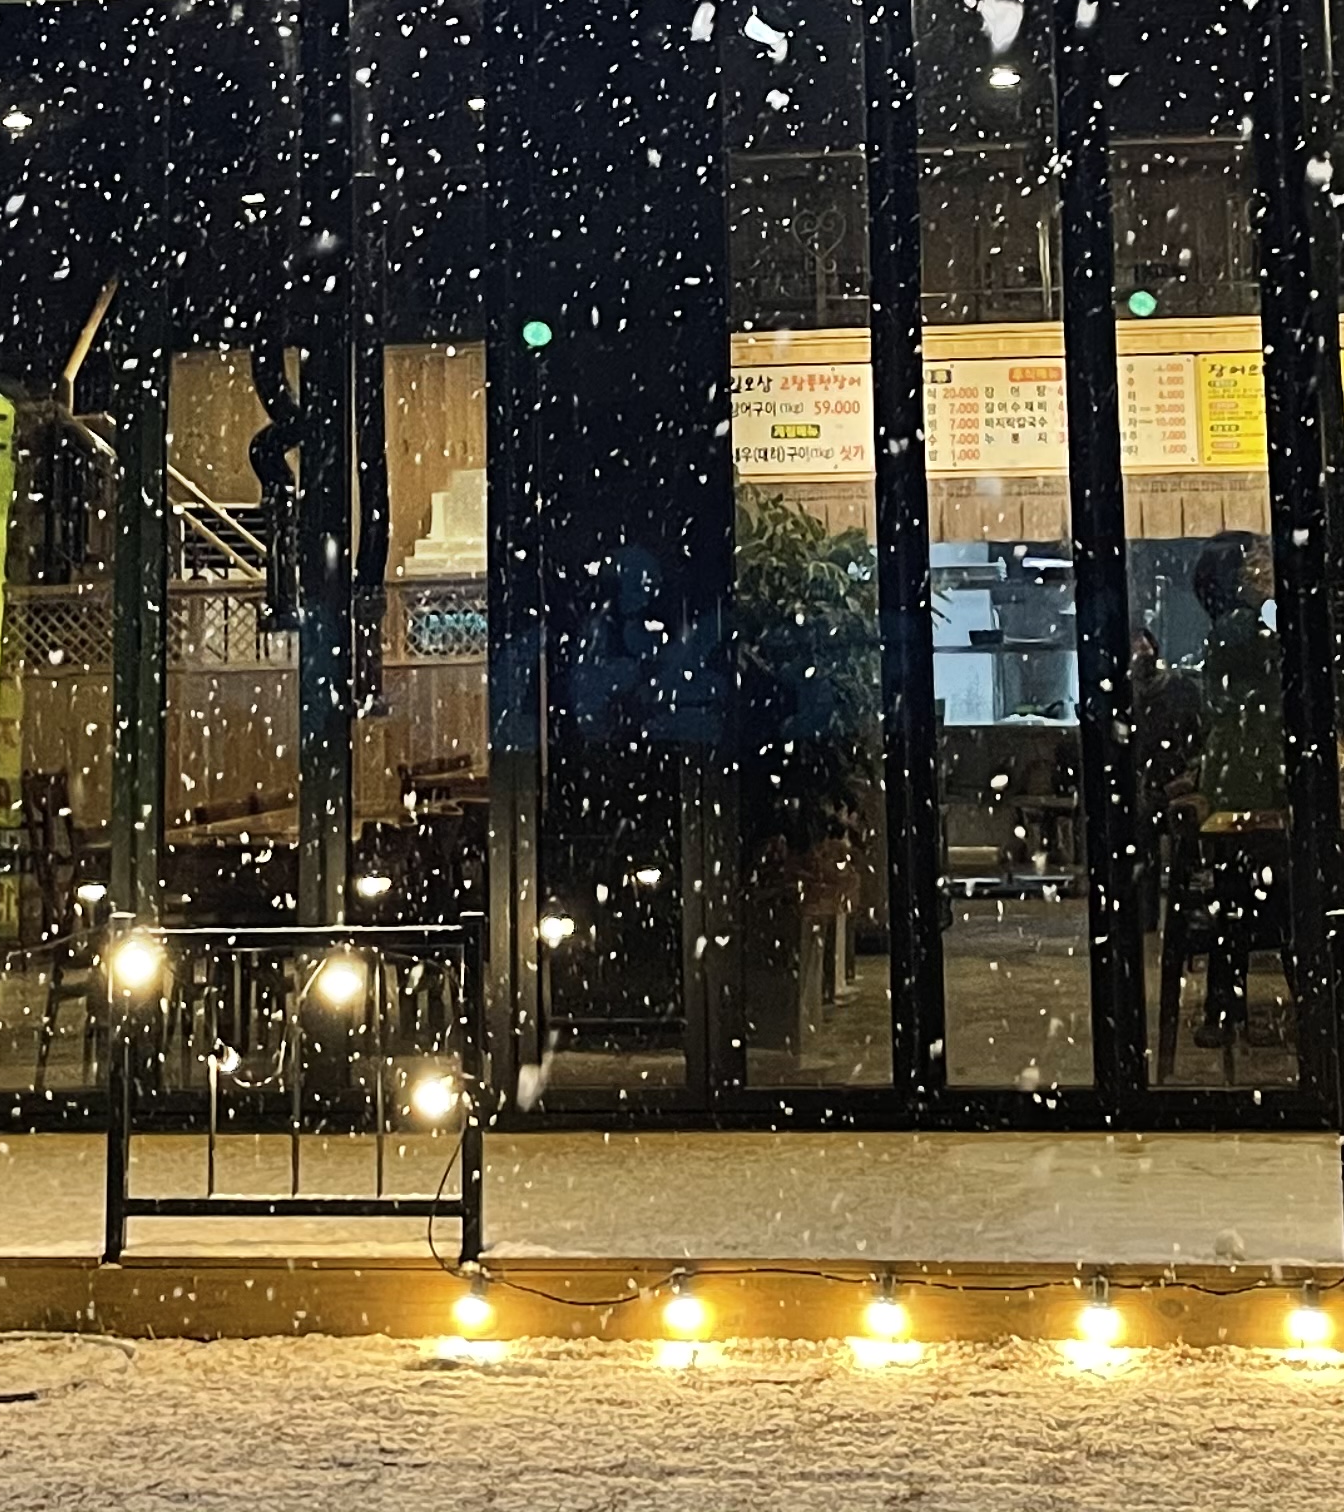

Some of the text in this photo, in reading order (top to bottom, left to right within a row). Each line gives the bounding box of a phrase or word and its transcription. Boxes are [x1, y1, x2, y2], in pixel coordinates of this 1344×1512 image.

[942, 387, 979, 399] 20.000
[813, 400, 861, 415] 59.000
[839, 444, 865, 462] 싯가
